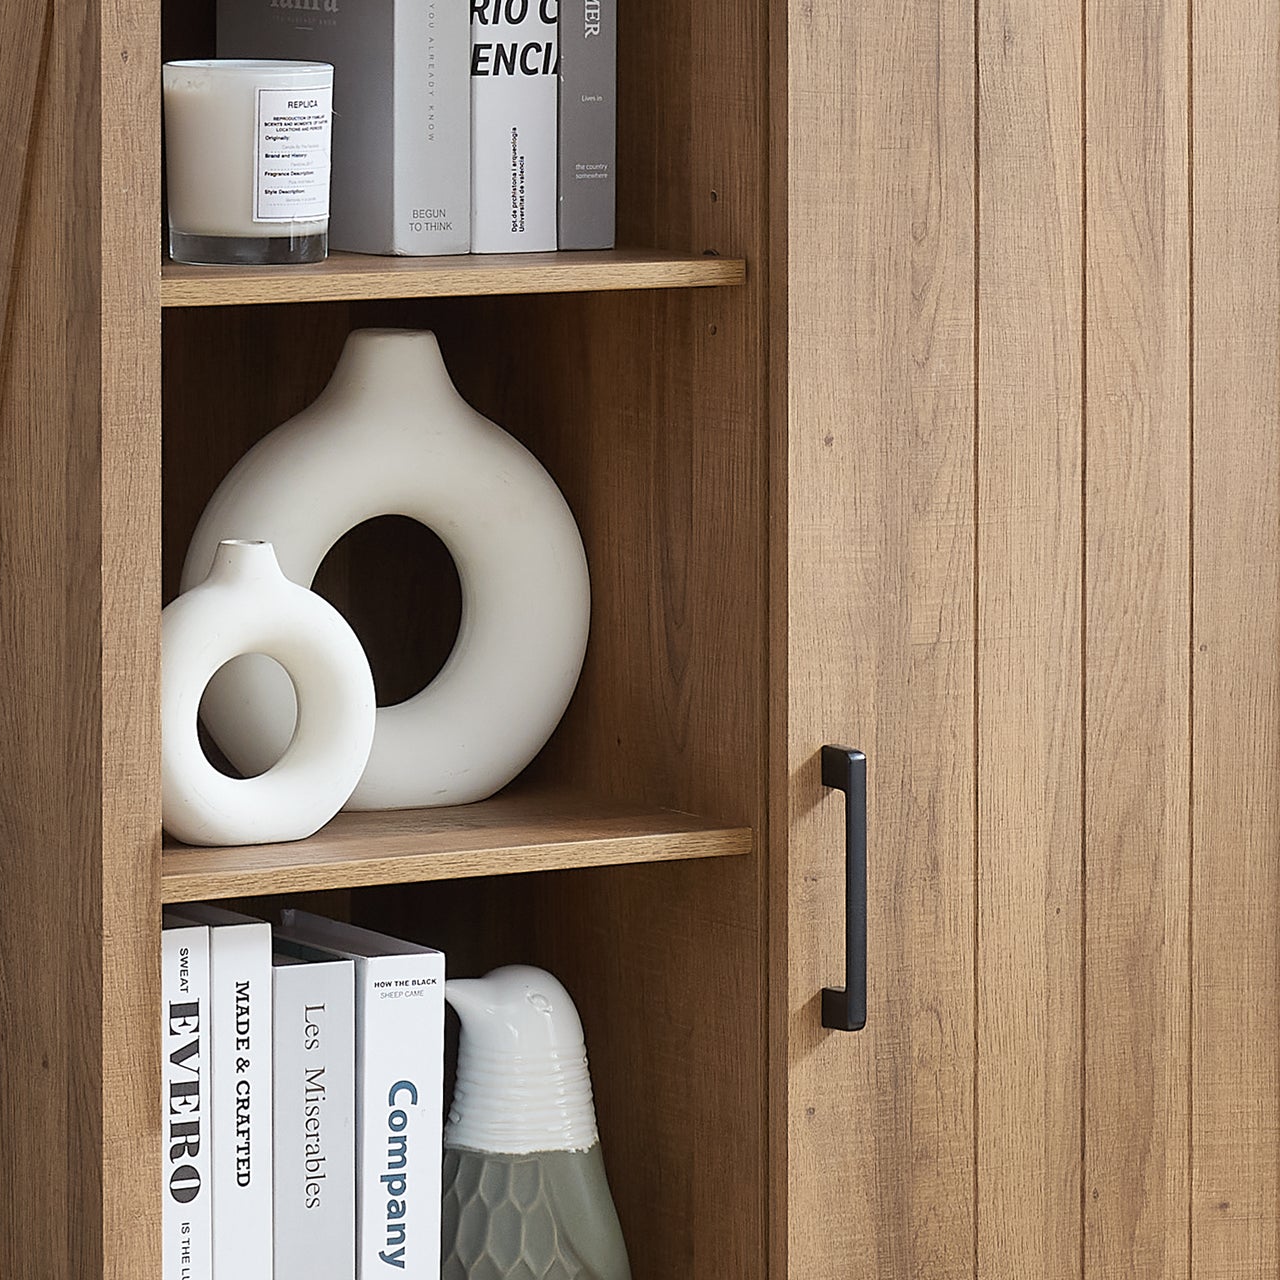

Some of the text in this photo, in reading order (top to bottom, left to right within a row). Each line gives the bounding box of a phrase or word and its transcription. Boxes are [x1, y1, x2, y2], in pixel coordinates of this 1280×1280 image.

[471, 42, 559, 77] ENCI
[287, 100, 318, 109] REPLICA
[409, 222, 453, 232] TO THINK
[412, 209, 446, 219] BEGUN
[179, 948, 189, 994] SWEAT
[411, 978, 437, 986] BLACK
[380, 991, 404, 999] SHEEP
[235, 981, 251, 1188] MADE & CRAFTED
[169, 998, 201, 1204] EVERO
[304, 1003, 326, 1209] Les Miserables
[378, 1080, 418, 1269] Company
[181, 1222, 191, 1234] IS
[181, 1238, 191, 1264] THE
